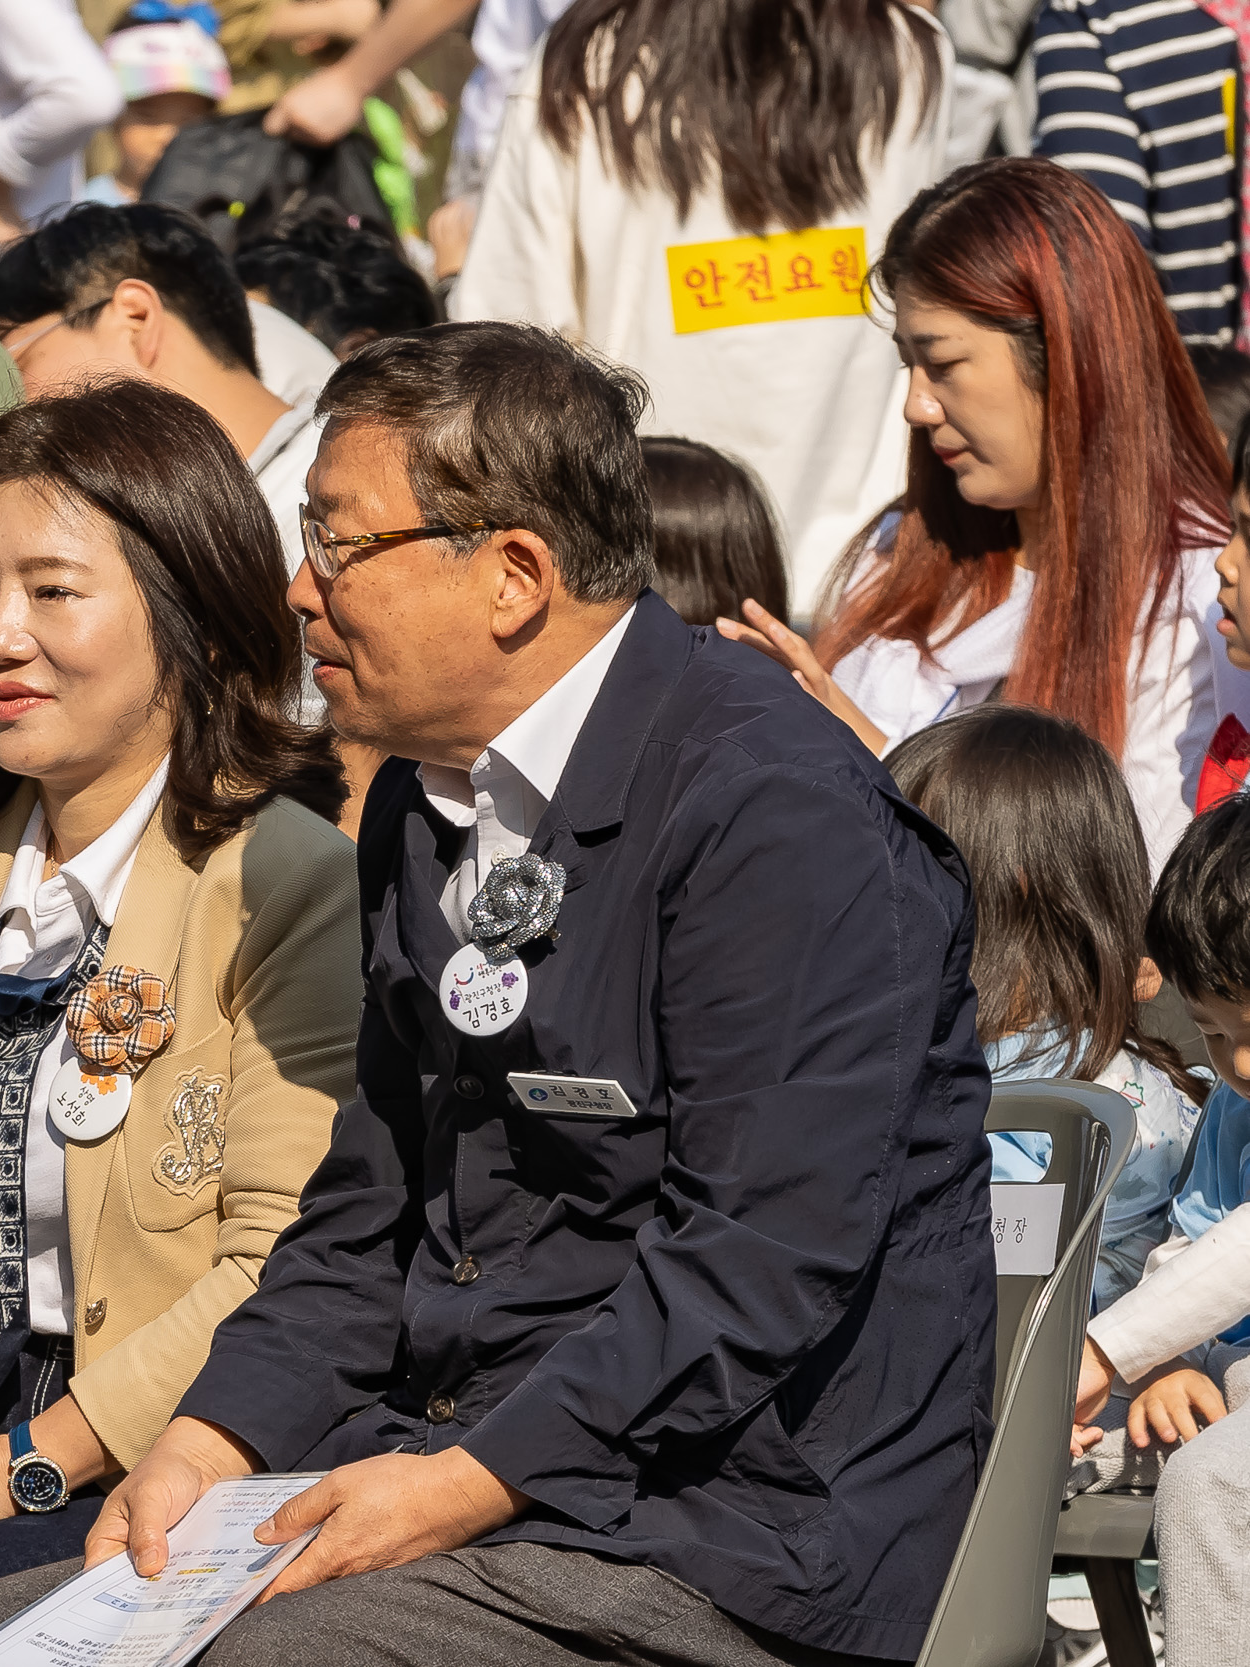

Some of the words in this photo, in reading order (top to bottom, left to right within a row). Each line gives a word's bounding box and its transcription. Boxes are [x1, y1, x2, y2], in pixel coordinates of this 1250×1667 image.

[684, 244, 862, 309] 안전요원
[462, 997, 514, 1029] 김경호
[56, 1091, 86, 1127] 노성희
[78, 1086, 95, 1106] 상명
